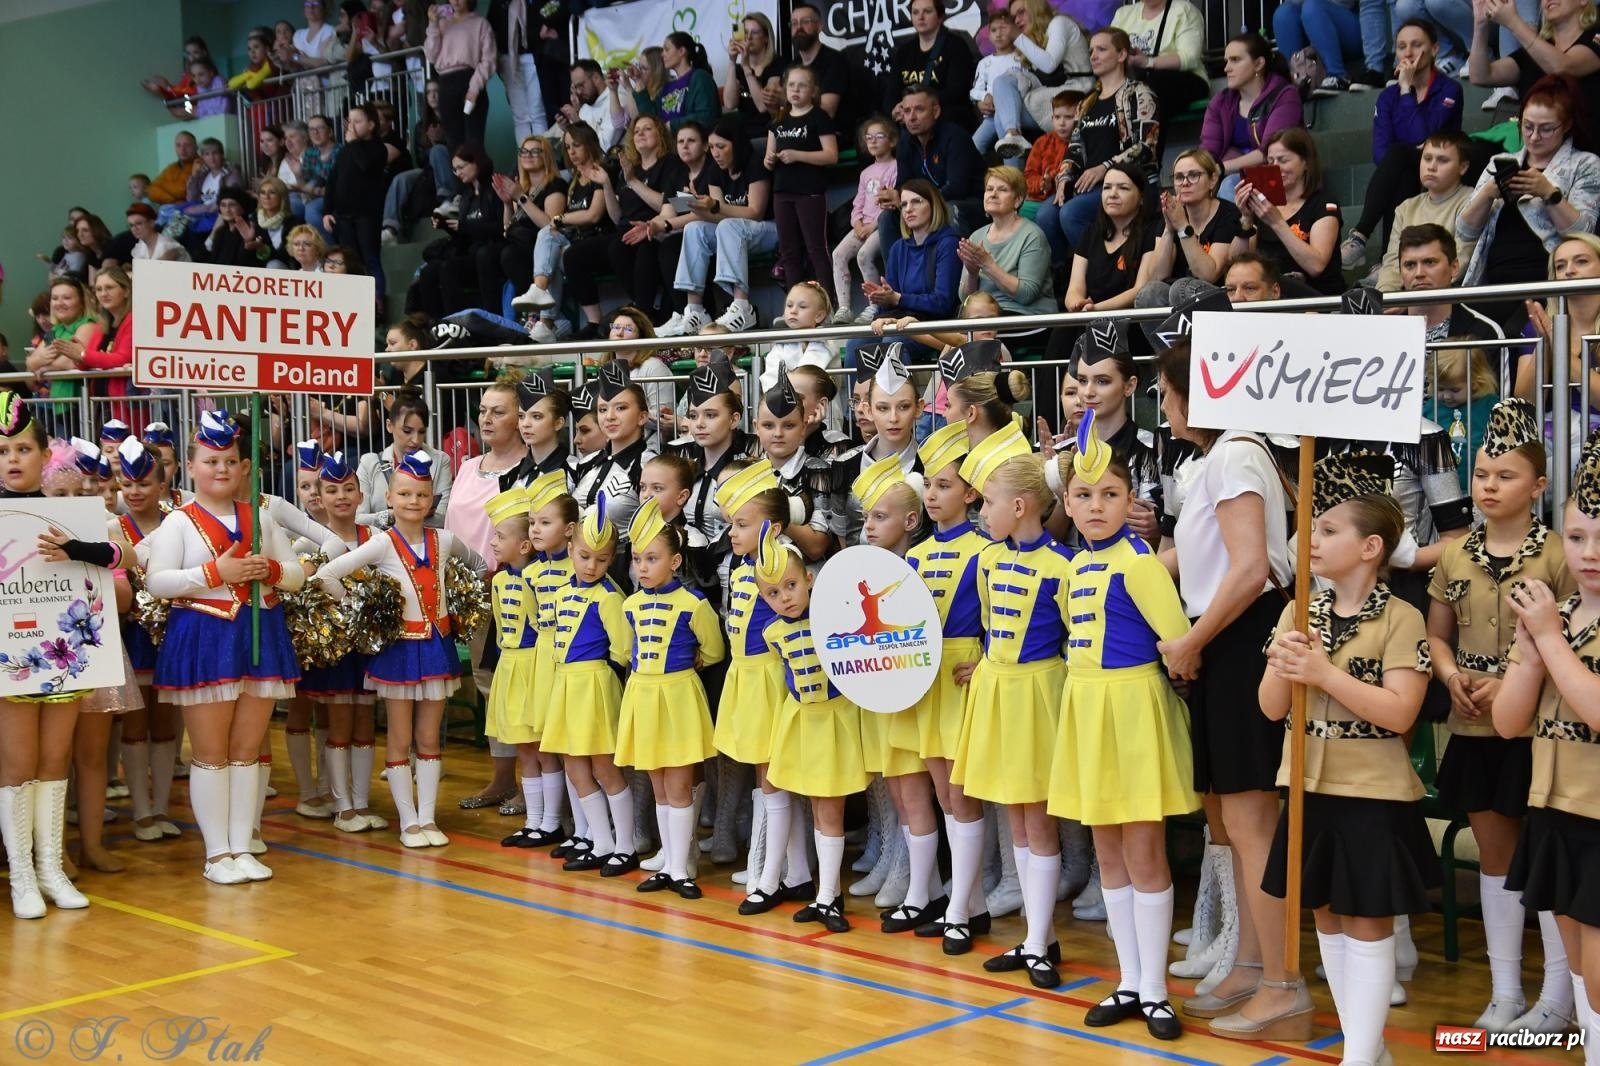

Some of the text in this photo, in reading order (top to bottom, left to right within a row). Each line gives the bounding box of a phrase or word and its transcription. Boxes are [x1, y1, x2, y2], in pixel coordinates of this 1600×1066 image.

[192, 270, 323, 299] MAŻORETKI
[155, 300, 358, 348] PANTERY
[148, 355, 358, 387] Gliwice Poland
[8, 630, 45, 640] POLAND
[899, 639, 928, 649] TANECZNY
[831, 652, 932, 676] MARKLOWICE
